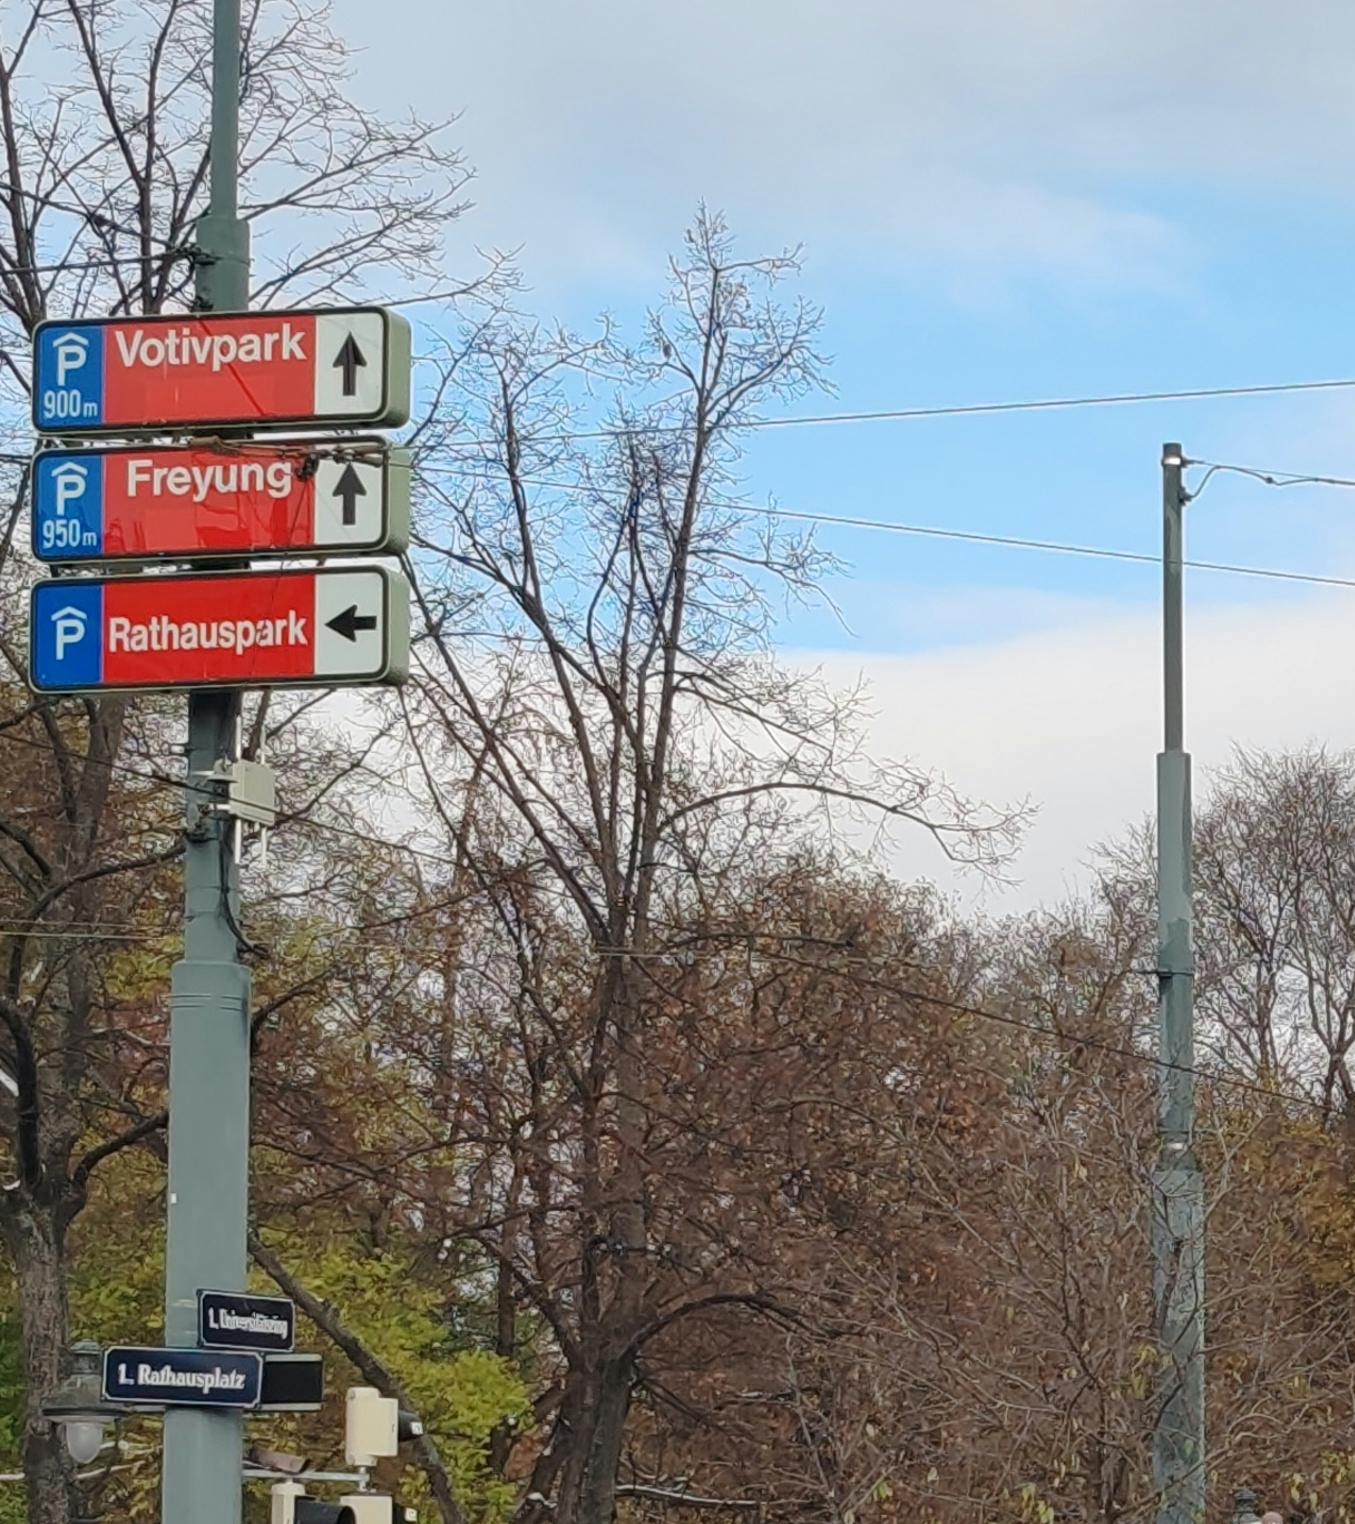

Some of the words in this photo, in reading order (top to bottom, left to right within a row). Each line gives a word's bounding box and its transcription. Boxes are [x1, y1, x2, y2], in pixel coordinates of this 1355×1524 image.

[115, 323, 307, 371] Votivpark
[126, 459, 293, 502] Freyung
[108, 610, 308, 654] Rathauspark
[137, 1364, 246, 1394] Rathausplatz
